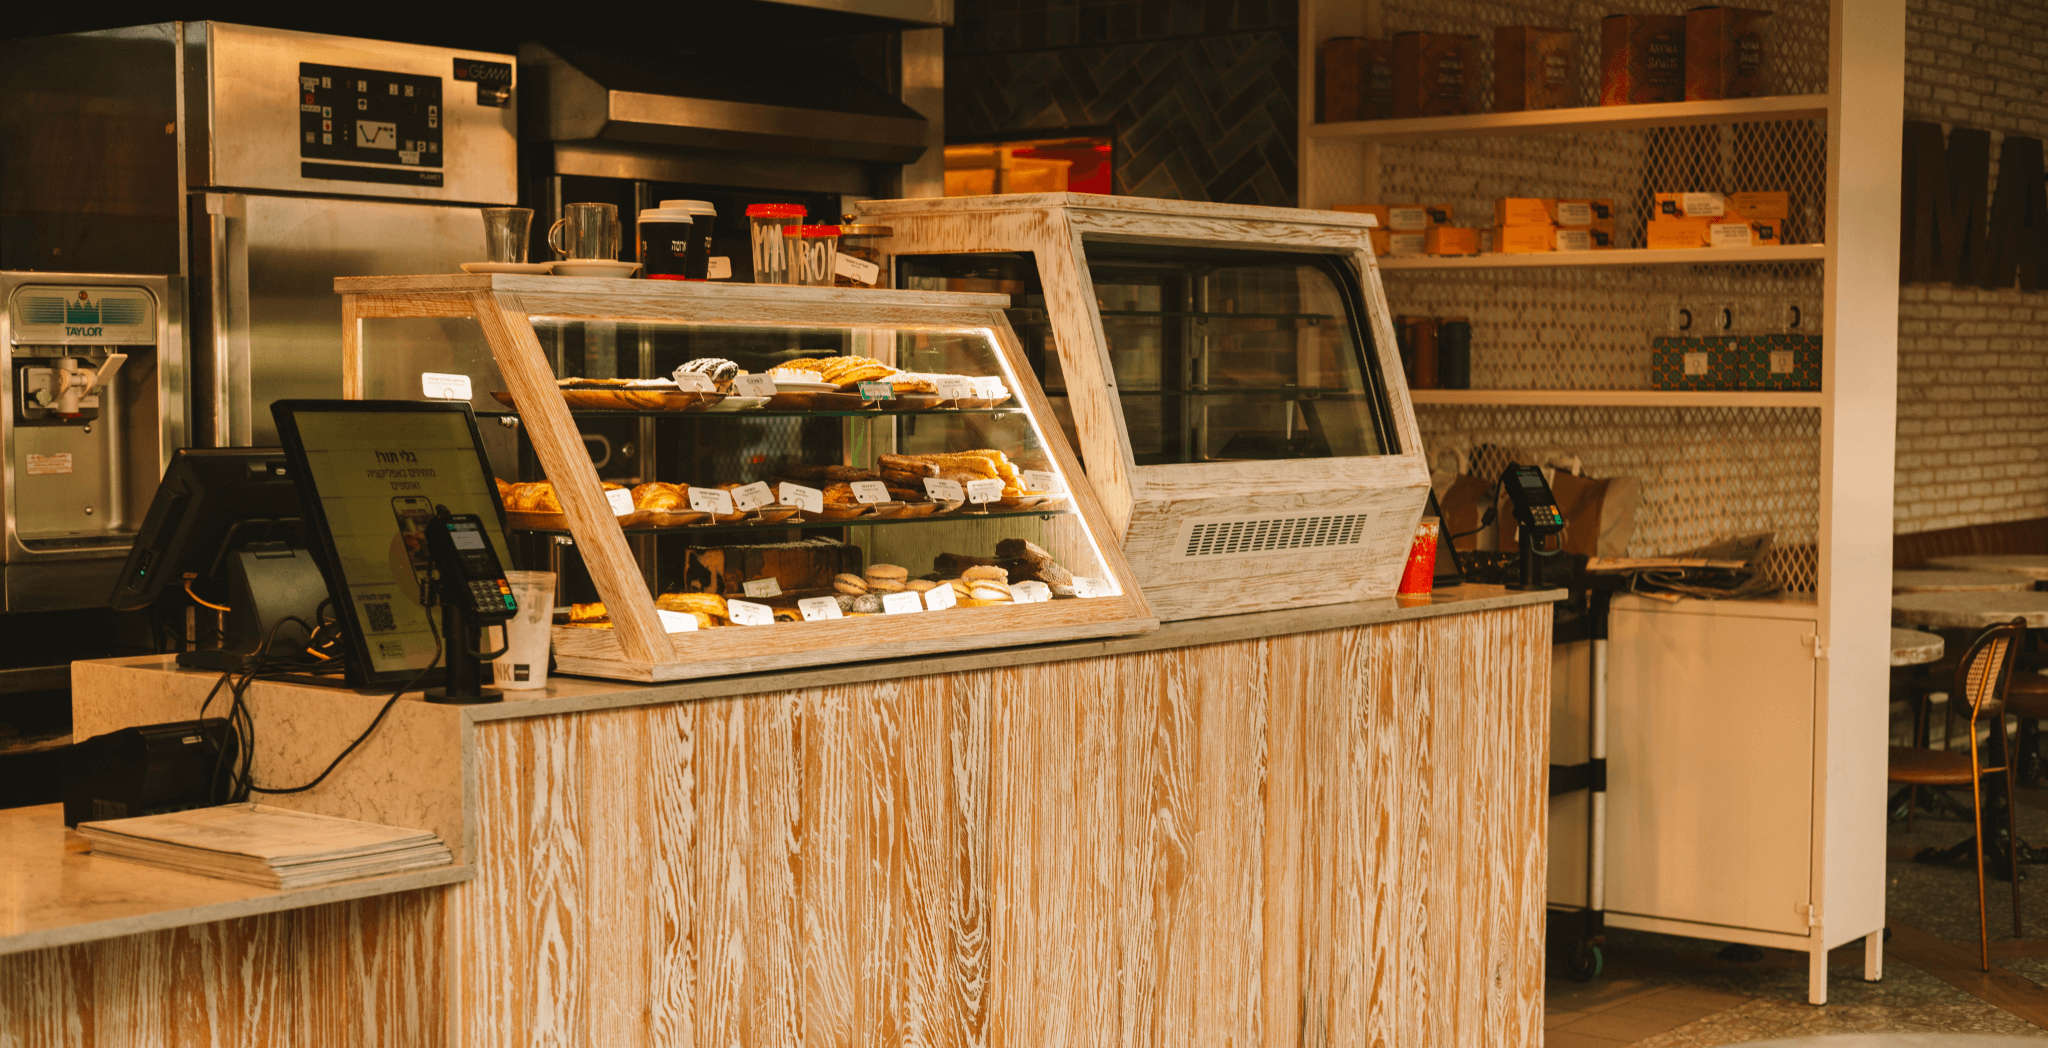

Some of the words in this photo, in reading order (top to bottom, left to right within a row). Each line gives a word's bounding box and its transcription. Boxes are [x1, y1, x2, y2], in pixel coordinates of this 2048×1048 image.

[468, 63, 510, 81] GEMM
[65, 327, 103, 337] TAYLOR
[374, 450, 399, 463] תור!
[398, 449, 418, 463] בלי
[366, 468, 408, 479] באפליקציה
[407, 468, 436, 478] מזמינים
[390, 481, 421, 490] ואוספים
